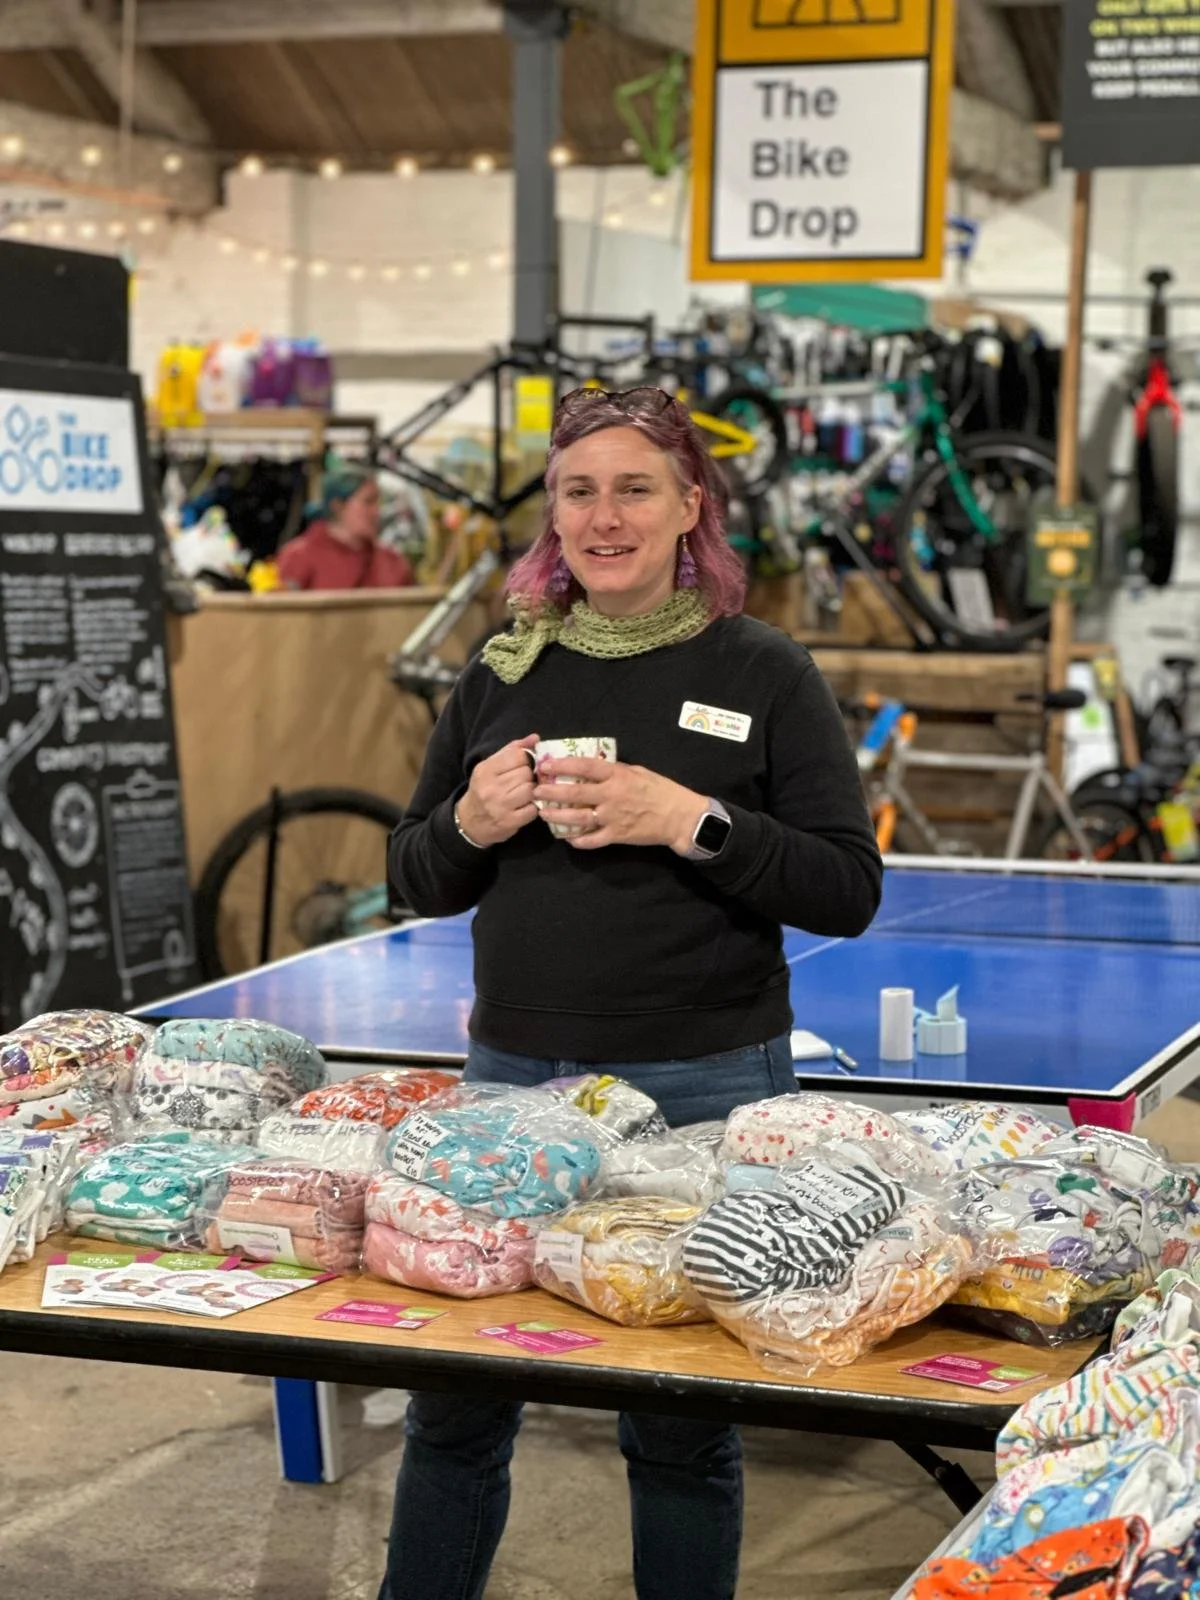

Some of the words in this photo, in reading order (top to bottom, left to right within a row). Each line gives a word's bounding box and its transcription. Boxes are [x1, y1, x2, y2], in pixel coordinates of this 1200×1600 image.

[1085, 60, 1133, 78] YOUR
[753, 80, 838, 119] The
[751, 140, 850, 179] Bike
[750, 199, 859, 247] Drop
[62, 431, 109, 461] BIKE
[63, 464, 122, 492] DROP
